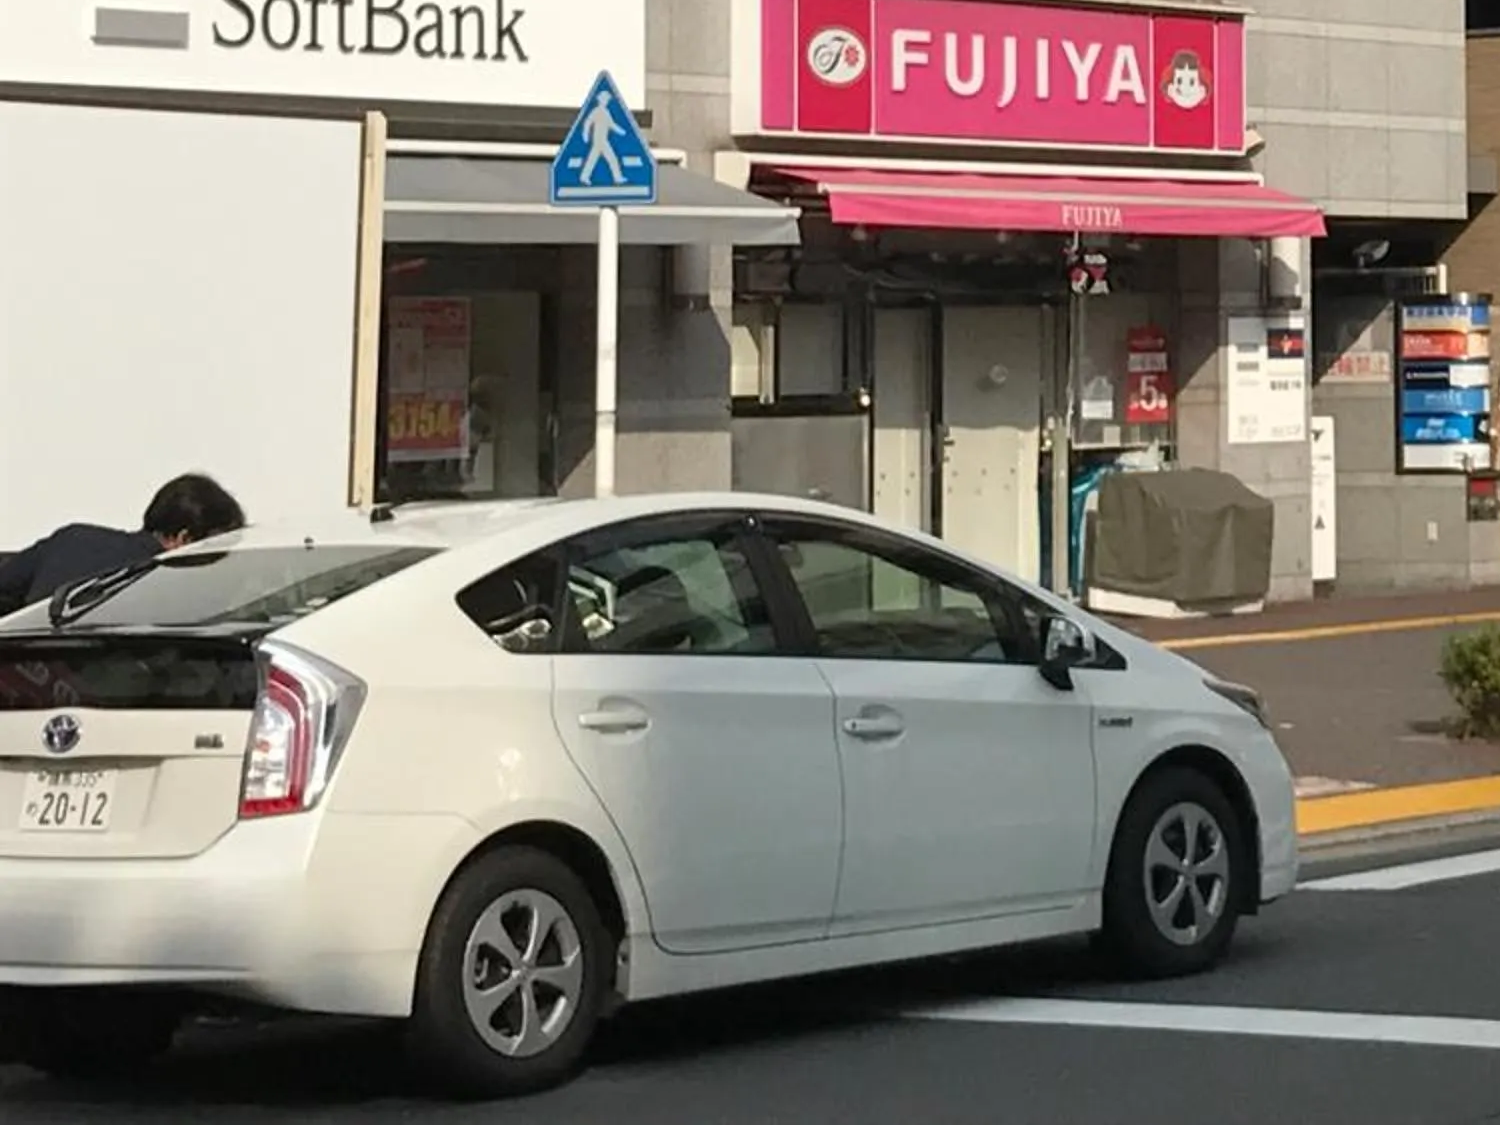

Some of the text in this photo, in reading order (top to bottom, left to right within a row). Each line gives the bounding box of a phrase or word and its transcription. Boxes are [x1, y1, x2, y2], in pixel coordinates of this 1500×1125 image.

[891, 28, 1147, 108] FUJIYA
[1061, 204, 1122, 228] FUJIYA
[38, 792, 108, 826] 20-12
